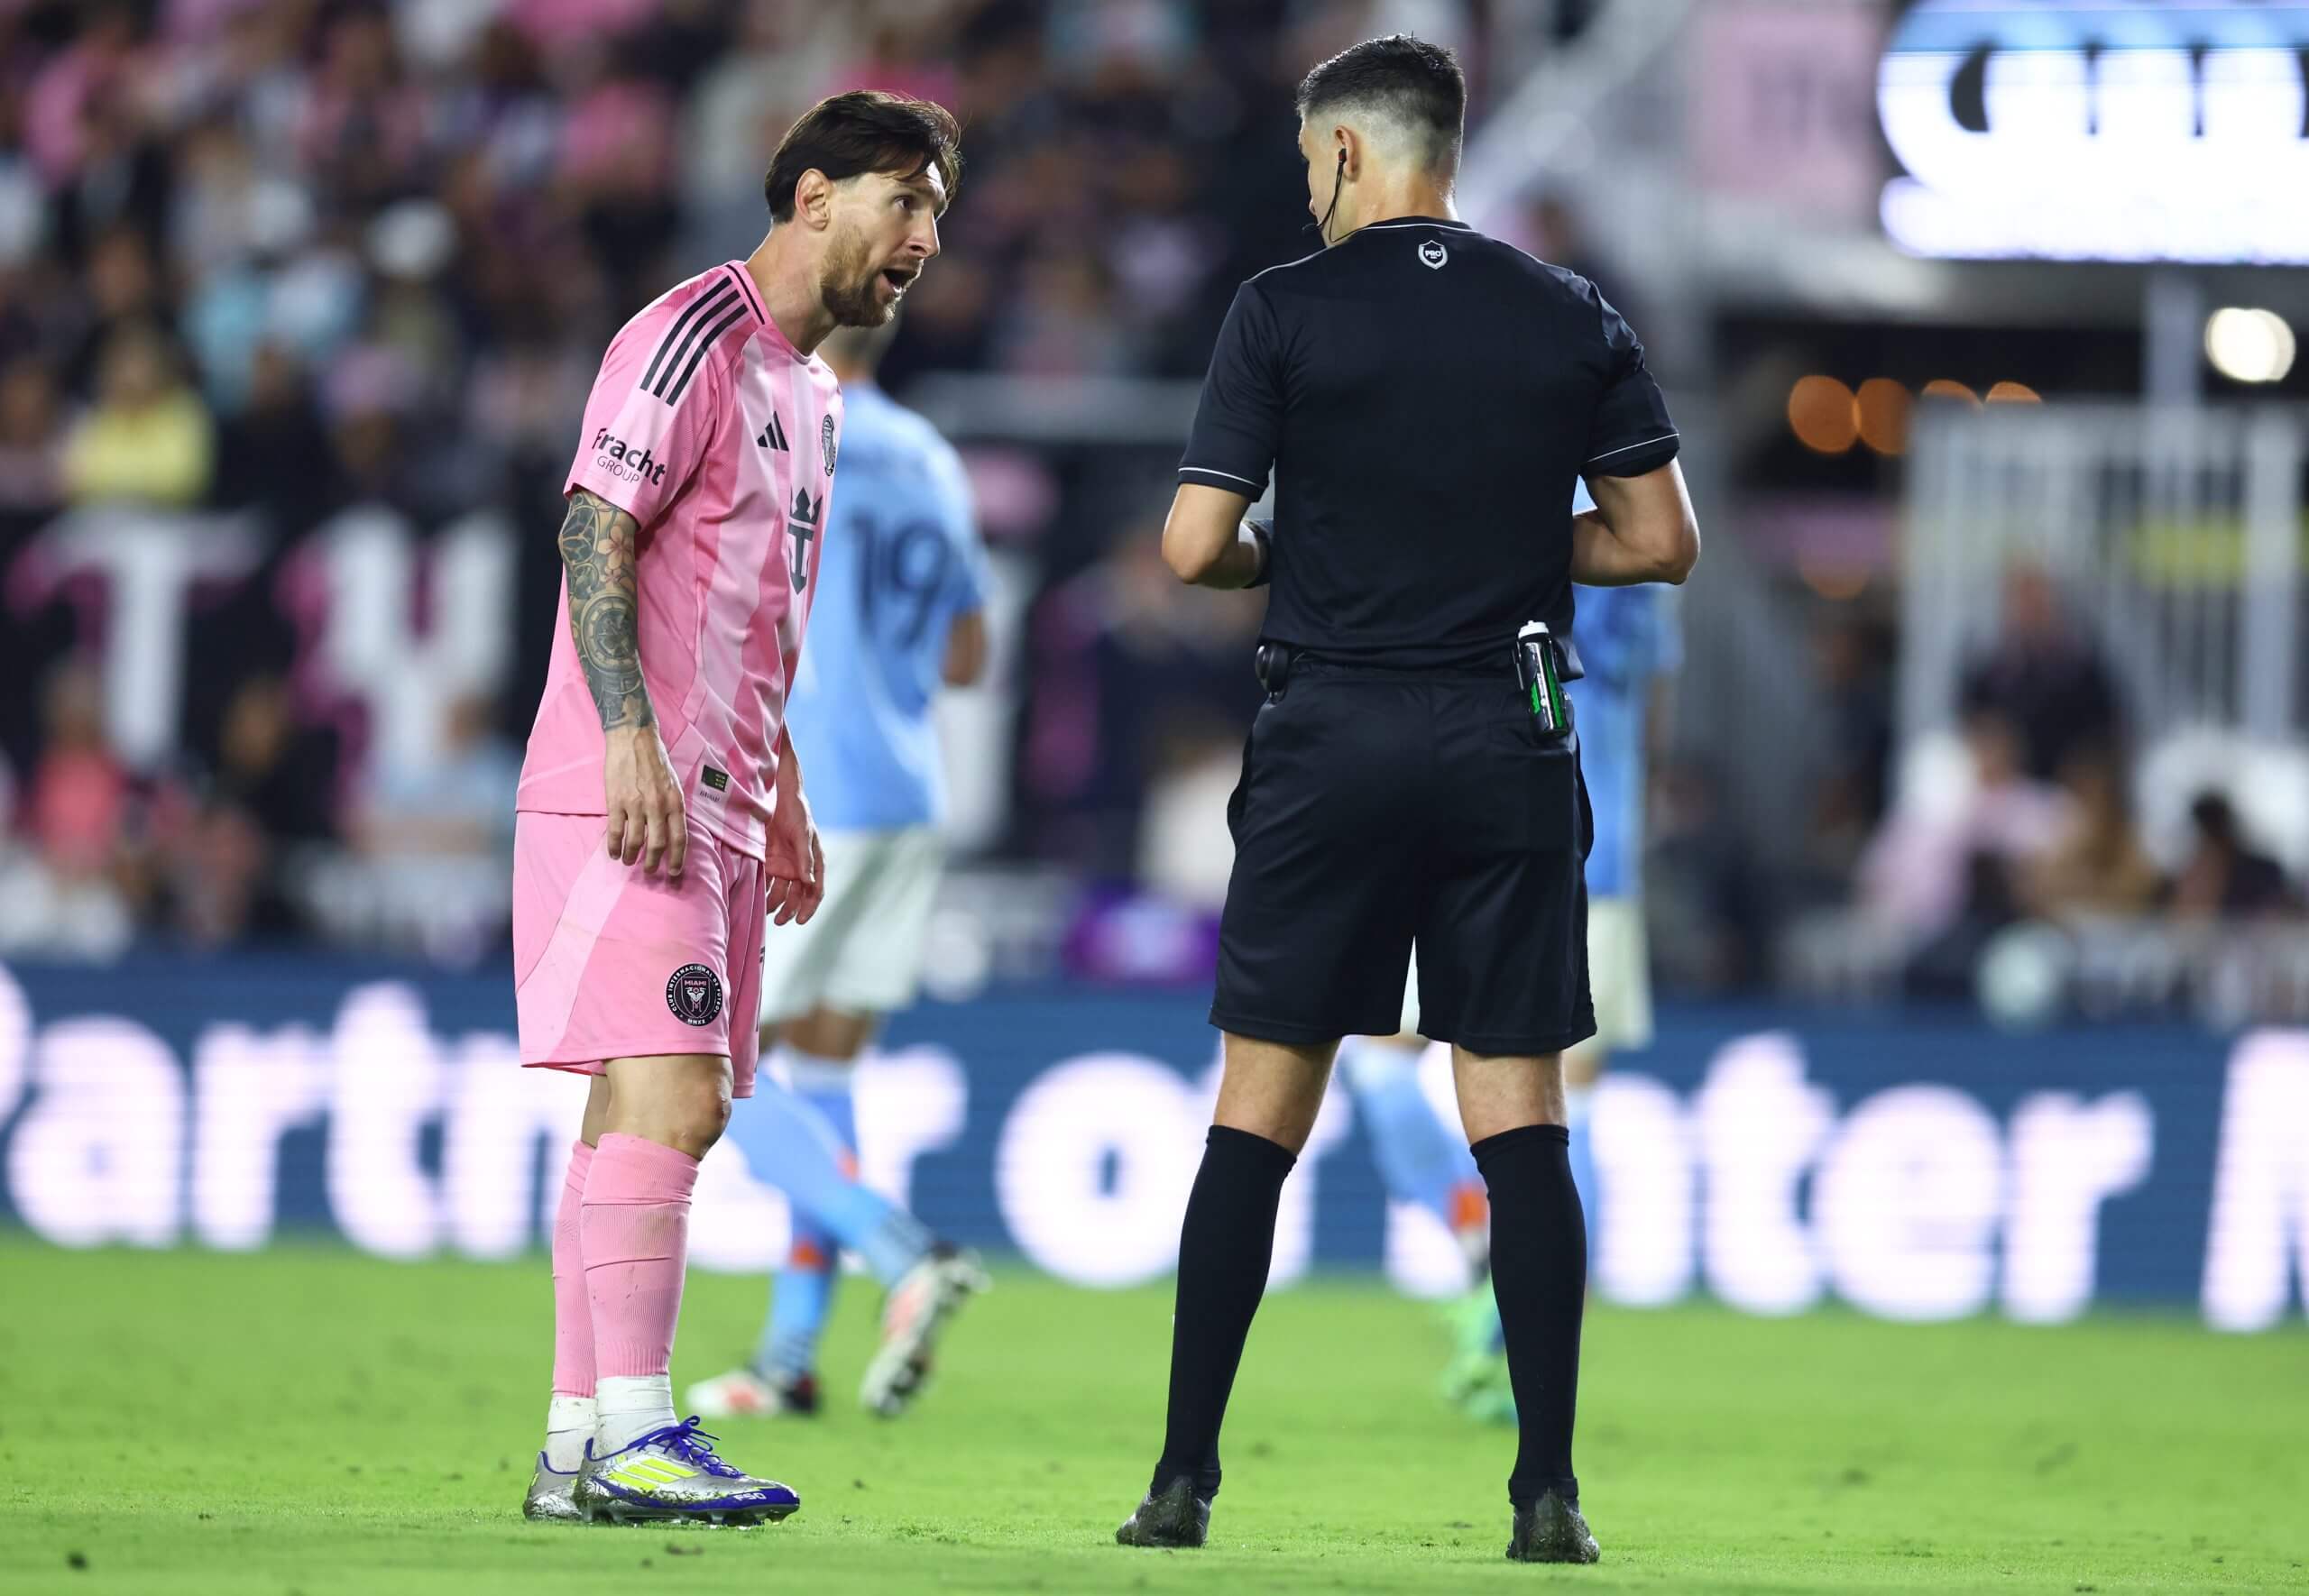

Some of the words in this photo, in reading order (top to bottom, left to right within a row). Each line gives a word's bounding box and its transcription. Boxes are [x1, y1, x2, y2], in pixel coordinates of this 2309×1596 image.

[592, 427, 666, 486] Fracht
[597, 455, 639, 483] GROUP
[849, 512, 951, 647] 19
[668, 966, 713, 991] INTERNACIONAL
[667, 994, 676, 1012] CLUB
[0, 958, 969, 1275] artnr
[733, 1491, 768, 1501] F50
